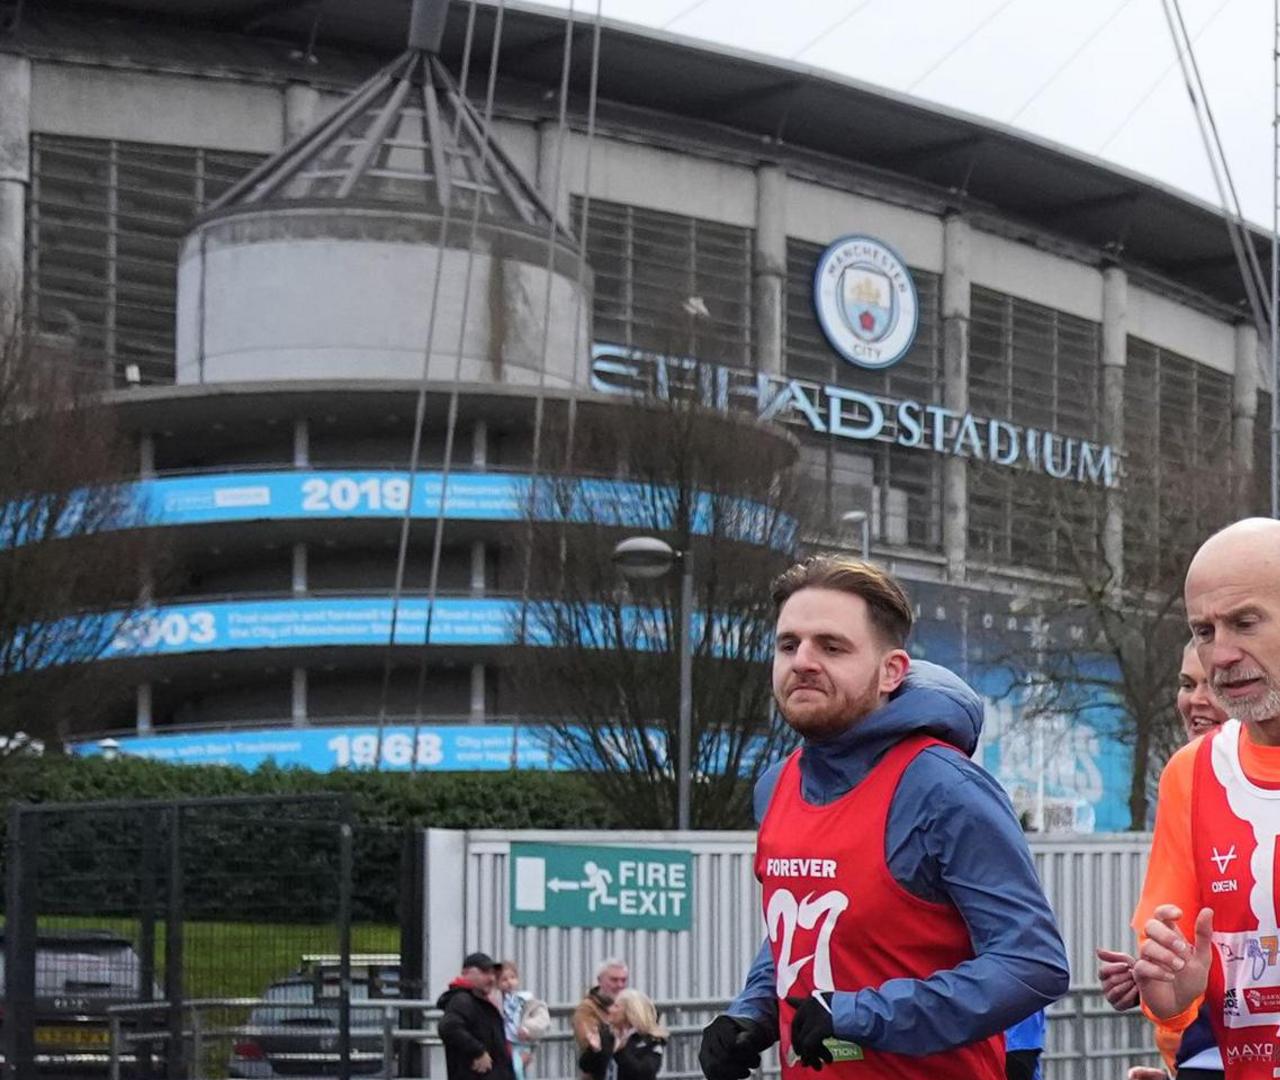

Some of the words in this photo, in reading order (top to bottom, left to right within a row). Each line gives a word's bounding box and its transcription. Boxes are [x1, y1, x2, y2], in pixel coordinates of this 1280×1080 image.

[854, 344, 882, 359] CITY
[590, 341, 884, 440] ETIHAD
[897, 400, 1114, 488] STADIUM
[301, 478, 410, 511] 2019
[328, 732, 444, 766] 1968
[619, 861, 687, 889] FIRE
[766, 858, 837, 878] FOREVER
[1211, 879, 1238, 893] OXEN
[619, 889, 687, 917] EXIT
[766, 888, 849, 1014] 27
[1226, 1043, 1274, 1056] MAYO
